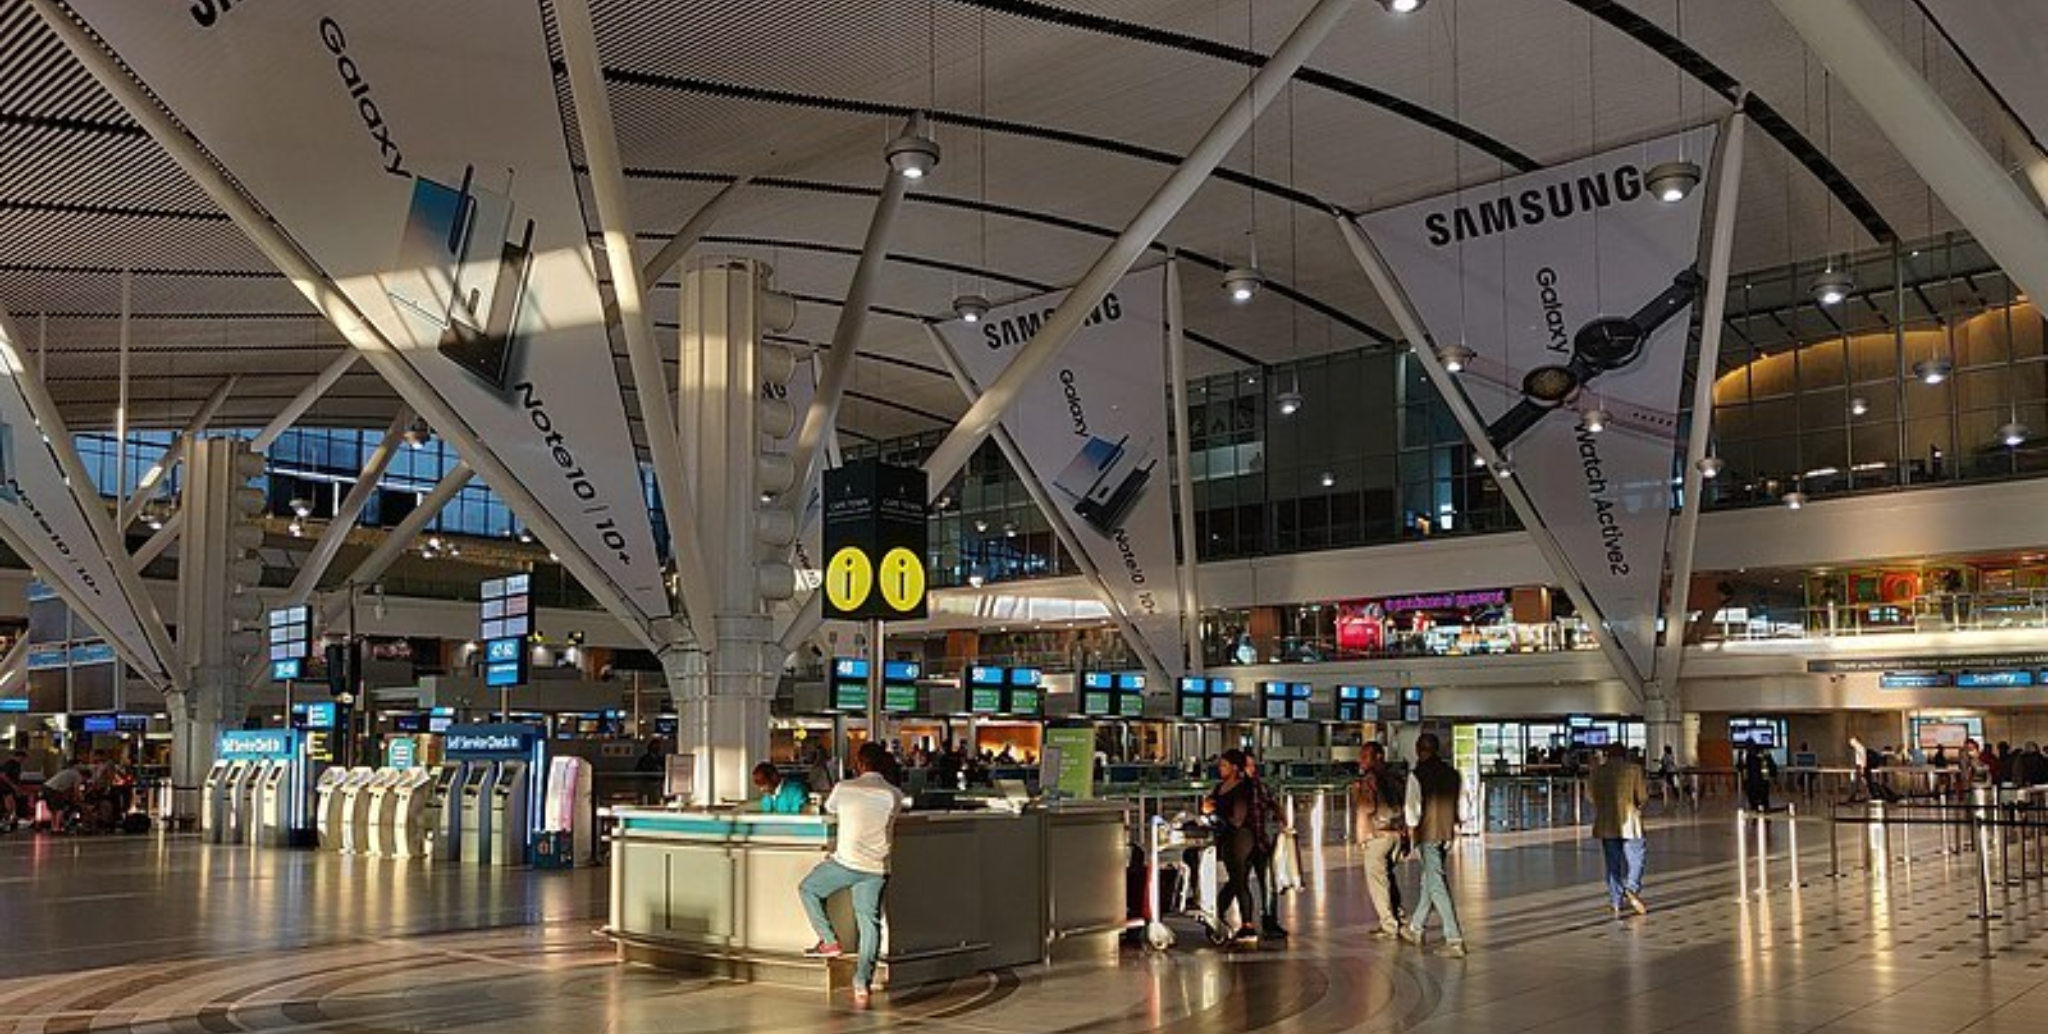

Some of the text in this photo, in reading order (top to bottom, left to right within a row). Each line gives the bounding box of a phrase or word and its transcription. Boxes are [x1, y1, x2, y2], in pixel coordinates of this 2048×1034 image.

[320, 16, 413, 179] Galaxy
[1425, 165, 1641, 246] SAMSUNG
[1536, 267, 1569, 354] Galaxy
[1059, 369, 1089, 437] Galaxy
[515, 377, 596, 501] Note10
[596, 518, 631, 565] 10+
[1574, 422, 1630, 576] Watch Active2
[8, 478, 70, 556] Note10
[1972, 672, 2016, 687] Security
